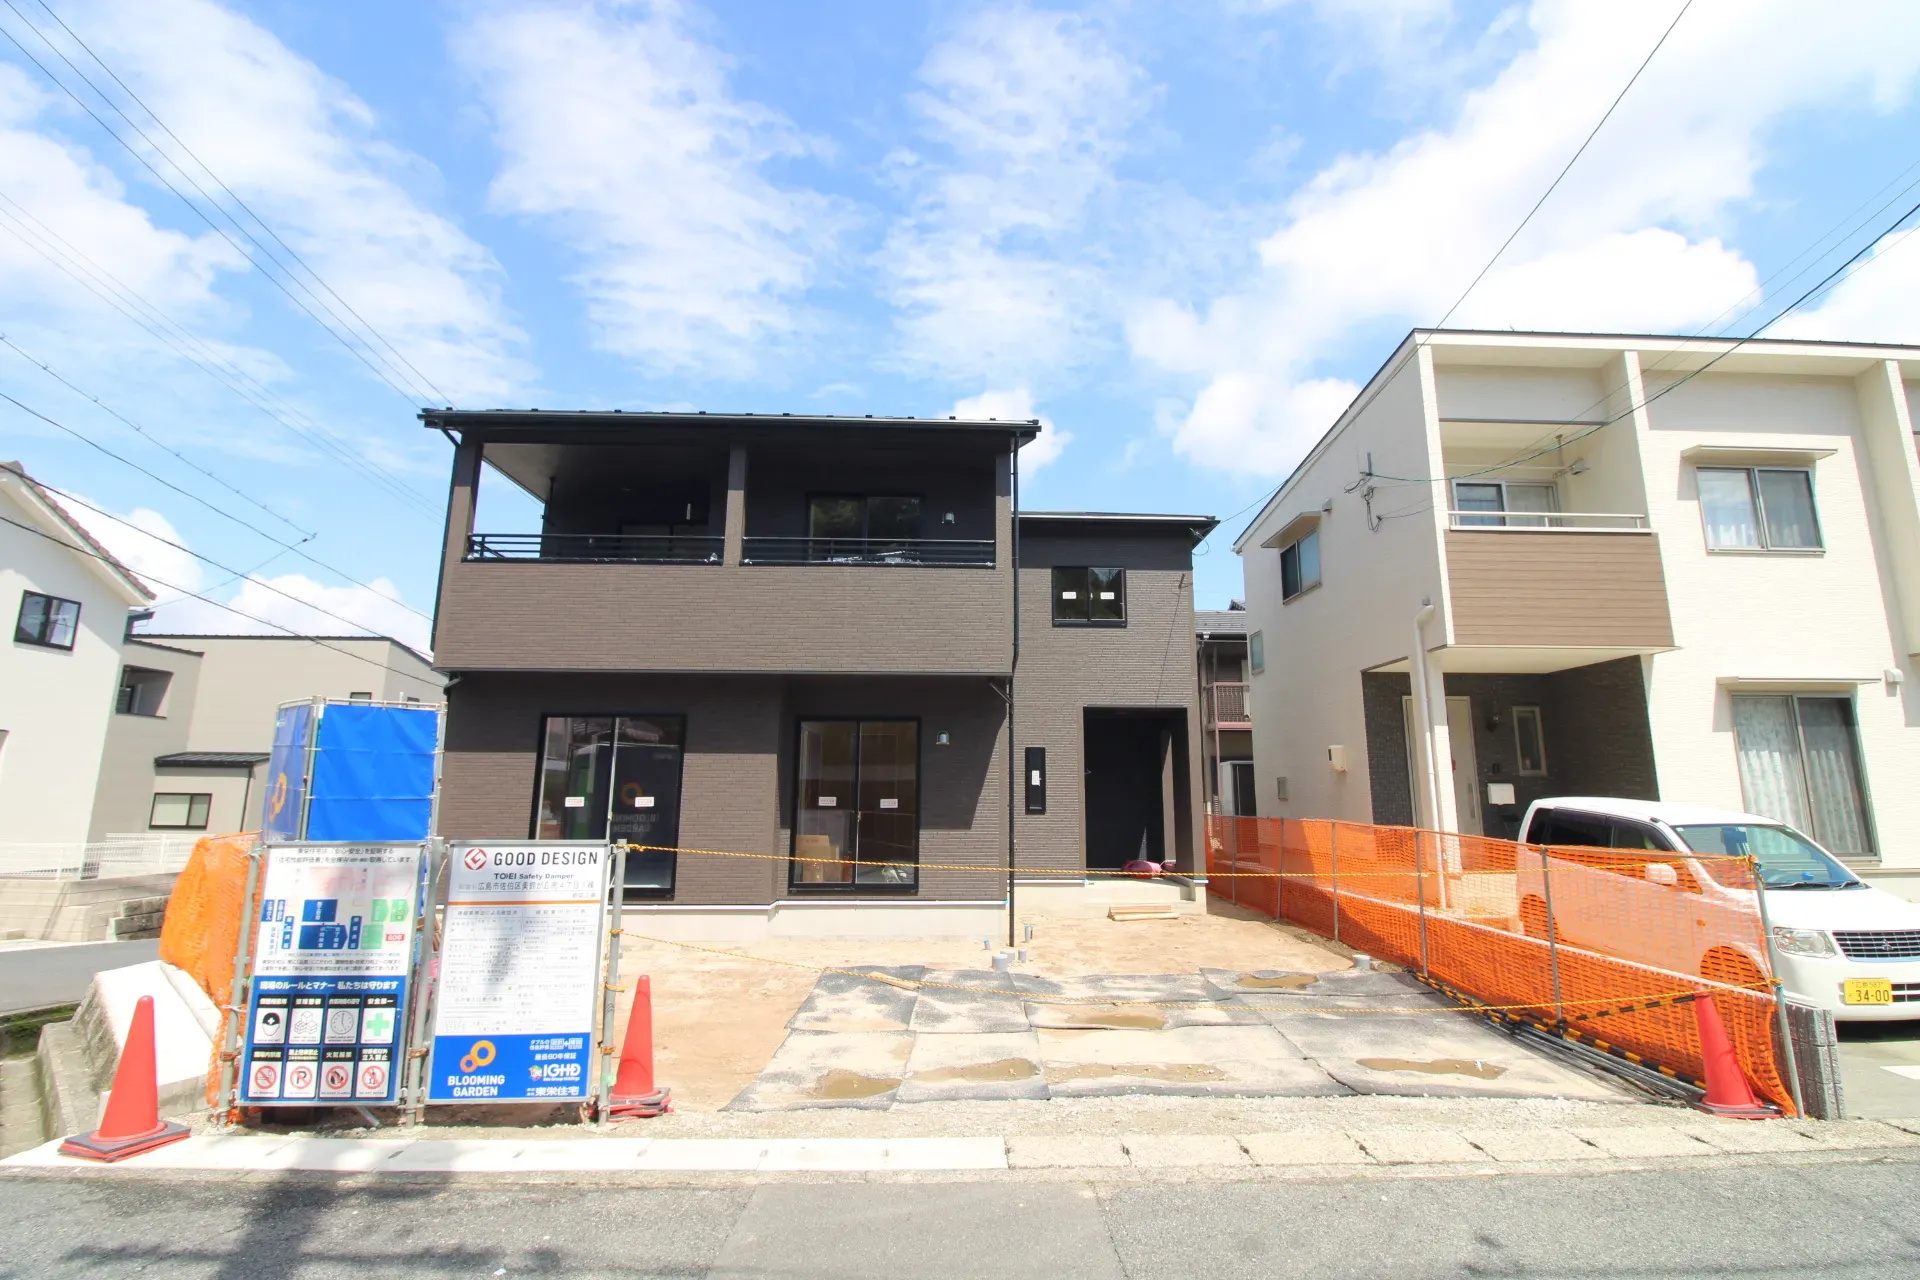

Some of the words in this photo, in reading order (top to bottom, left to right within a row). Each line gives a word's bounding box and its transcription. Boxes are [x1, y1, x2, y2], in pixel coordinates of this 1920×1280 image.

[494, 852, 536, 866] GOOD
[541, 851, 599, 866] DESIGN
[519, 873, 543, 881] Safety
[545, 873, 575, 881] Damper
[337, 981, 399, 990] 私たちは守ります
[1855, 989, 1890, 1002] 34-00
[447, 1075, 506, 1086] BLOOMING
[453, 1086, 498, 1097] GARDEN
